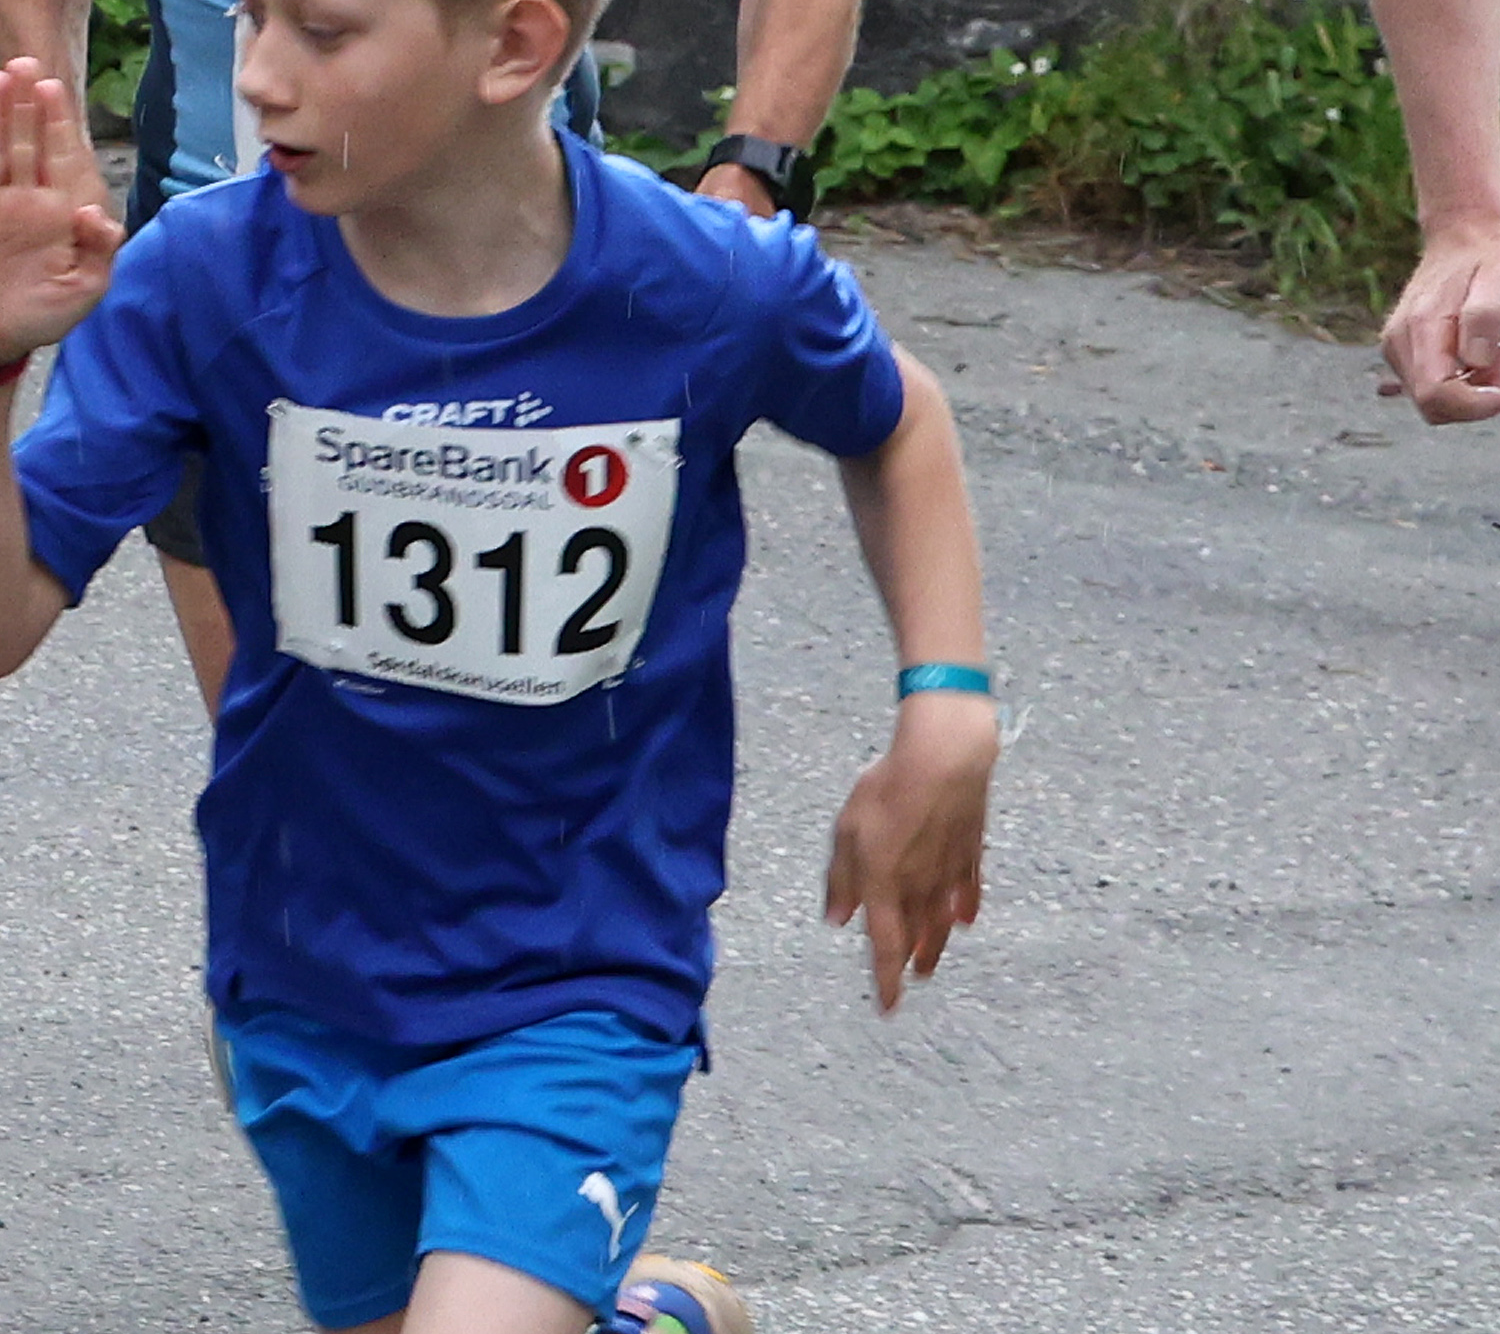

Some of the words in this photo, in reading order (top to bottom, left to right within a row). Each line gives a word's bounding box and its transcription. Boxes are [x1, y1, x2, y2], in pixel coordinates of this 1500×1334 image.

[382, 398, 515, 427] CRAFT
[315, 427, 553, 485] SpareBank
[311, 510, 629, 656] 1312
